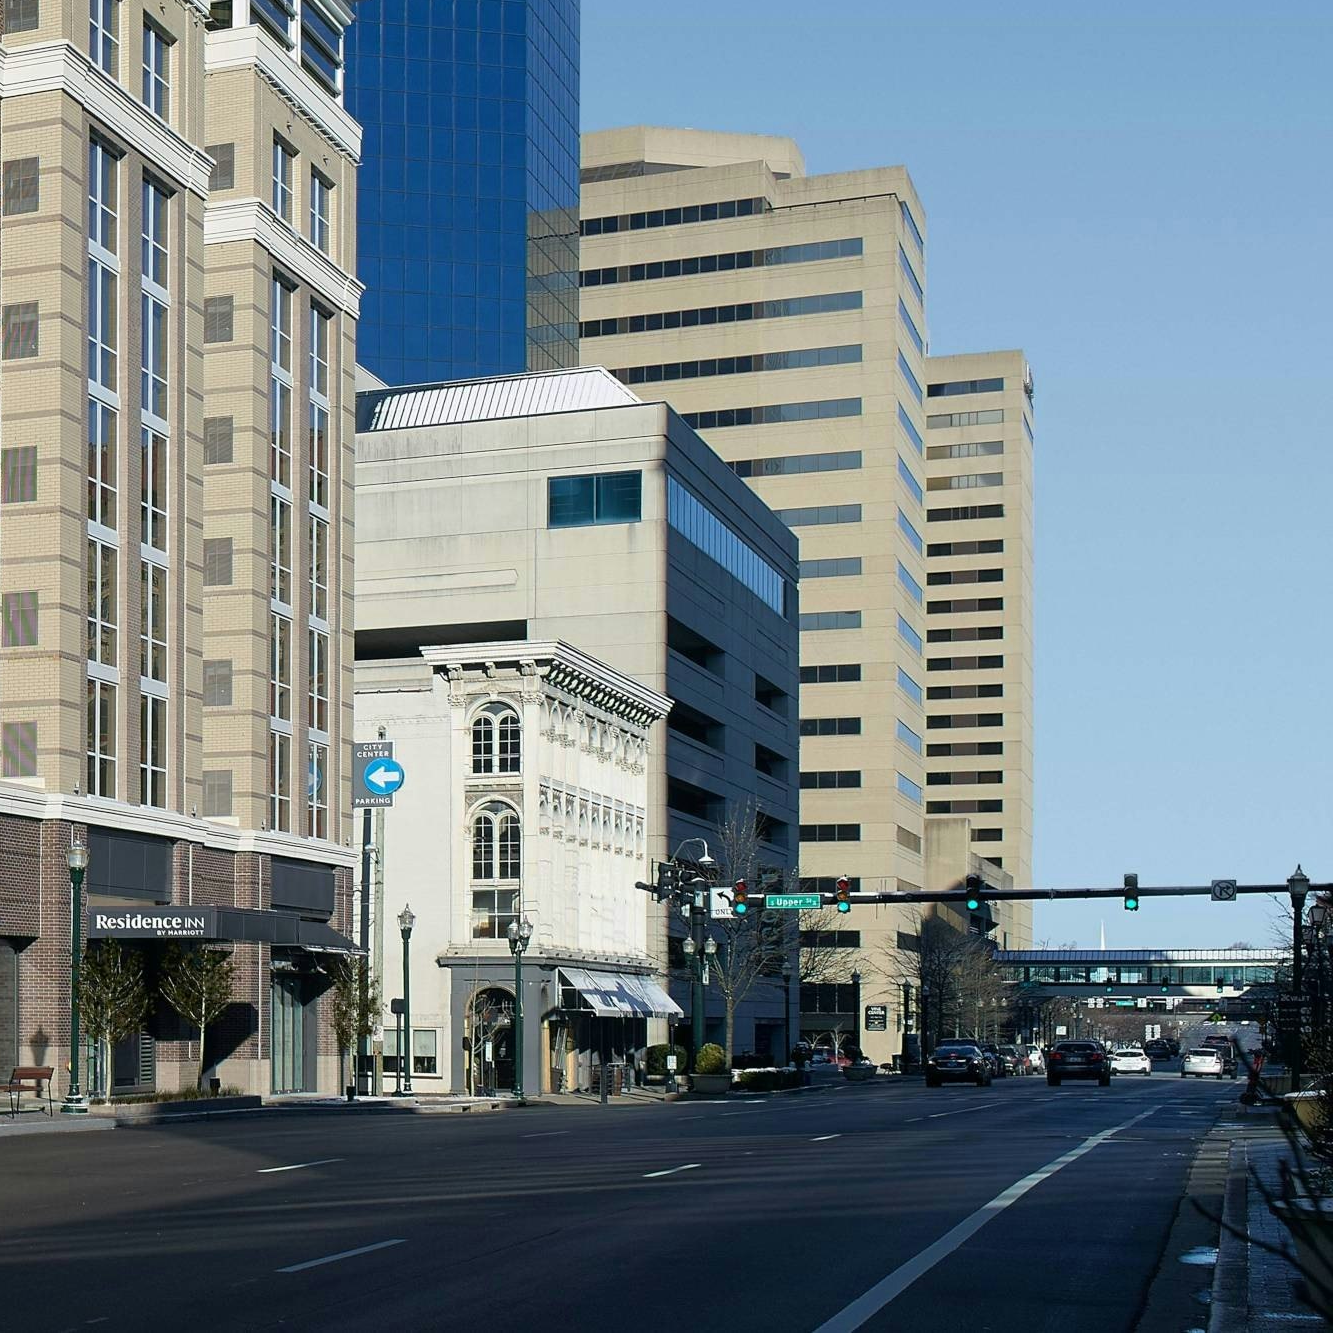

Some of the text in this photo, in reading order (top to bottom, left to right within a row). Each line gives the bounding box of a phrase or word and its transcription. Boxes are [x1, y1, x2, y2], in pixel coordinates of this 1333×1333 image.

[355, 797, 391, 805] PARKING
[776, 897, 803, 907] Upper
[96, 914, 205, 930] Residence INN
